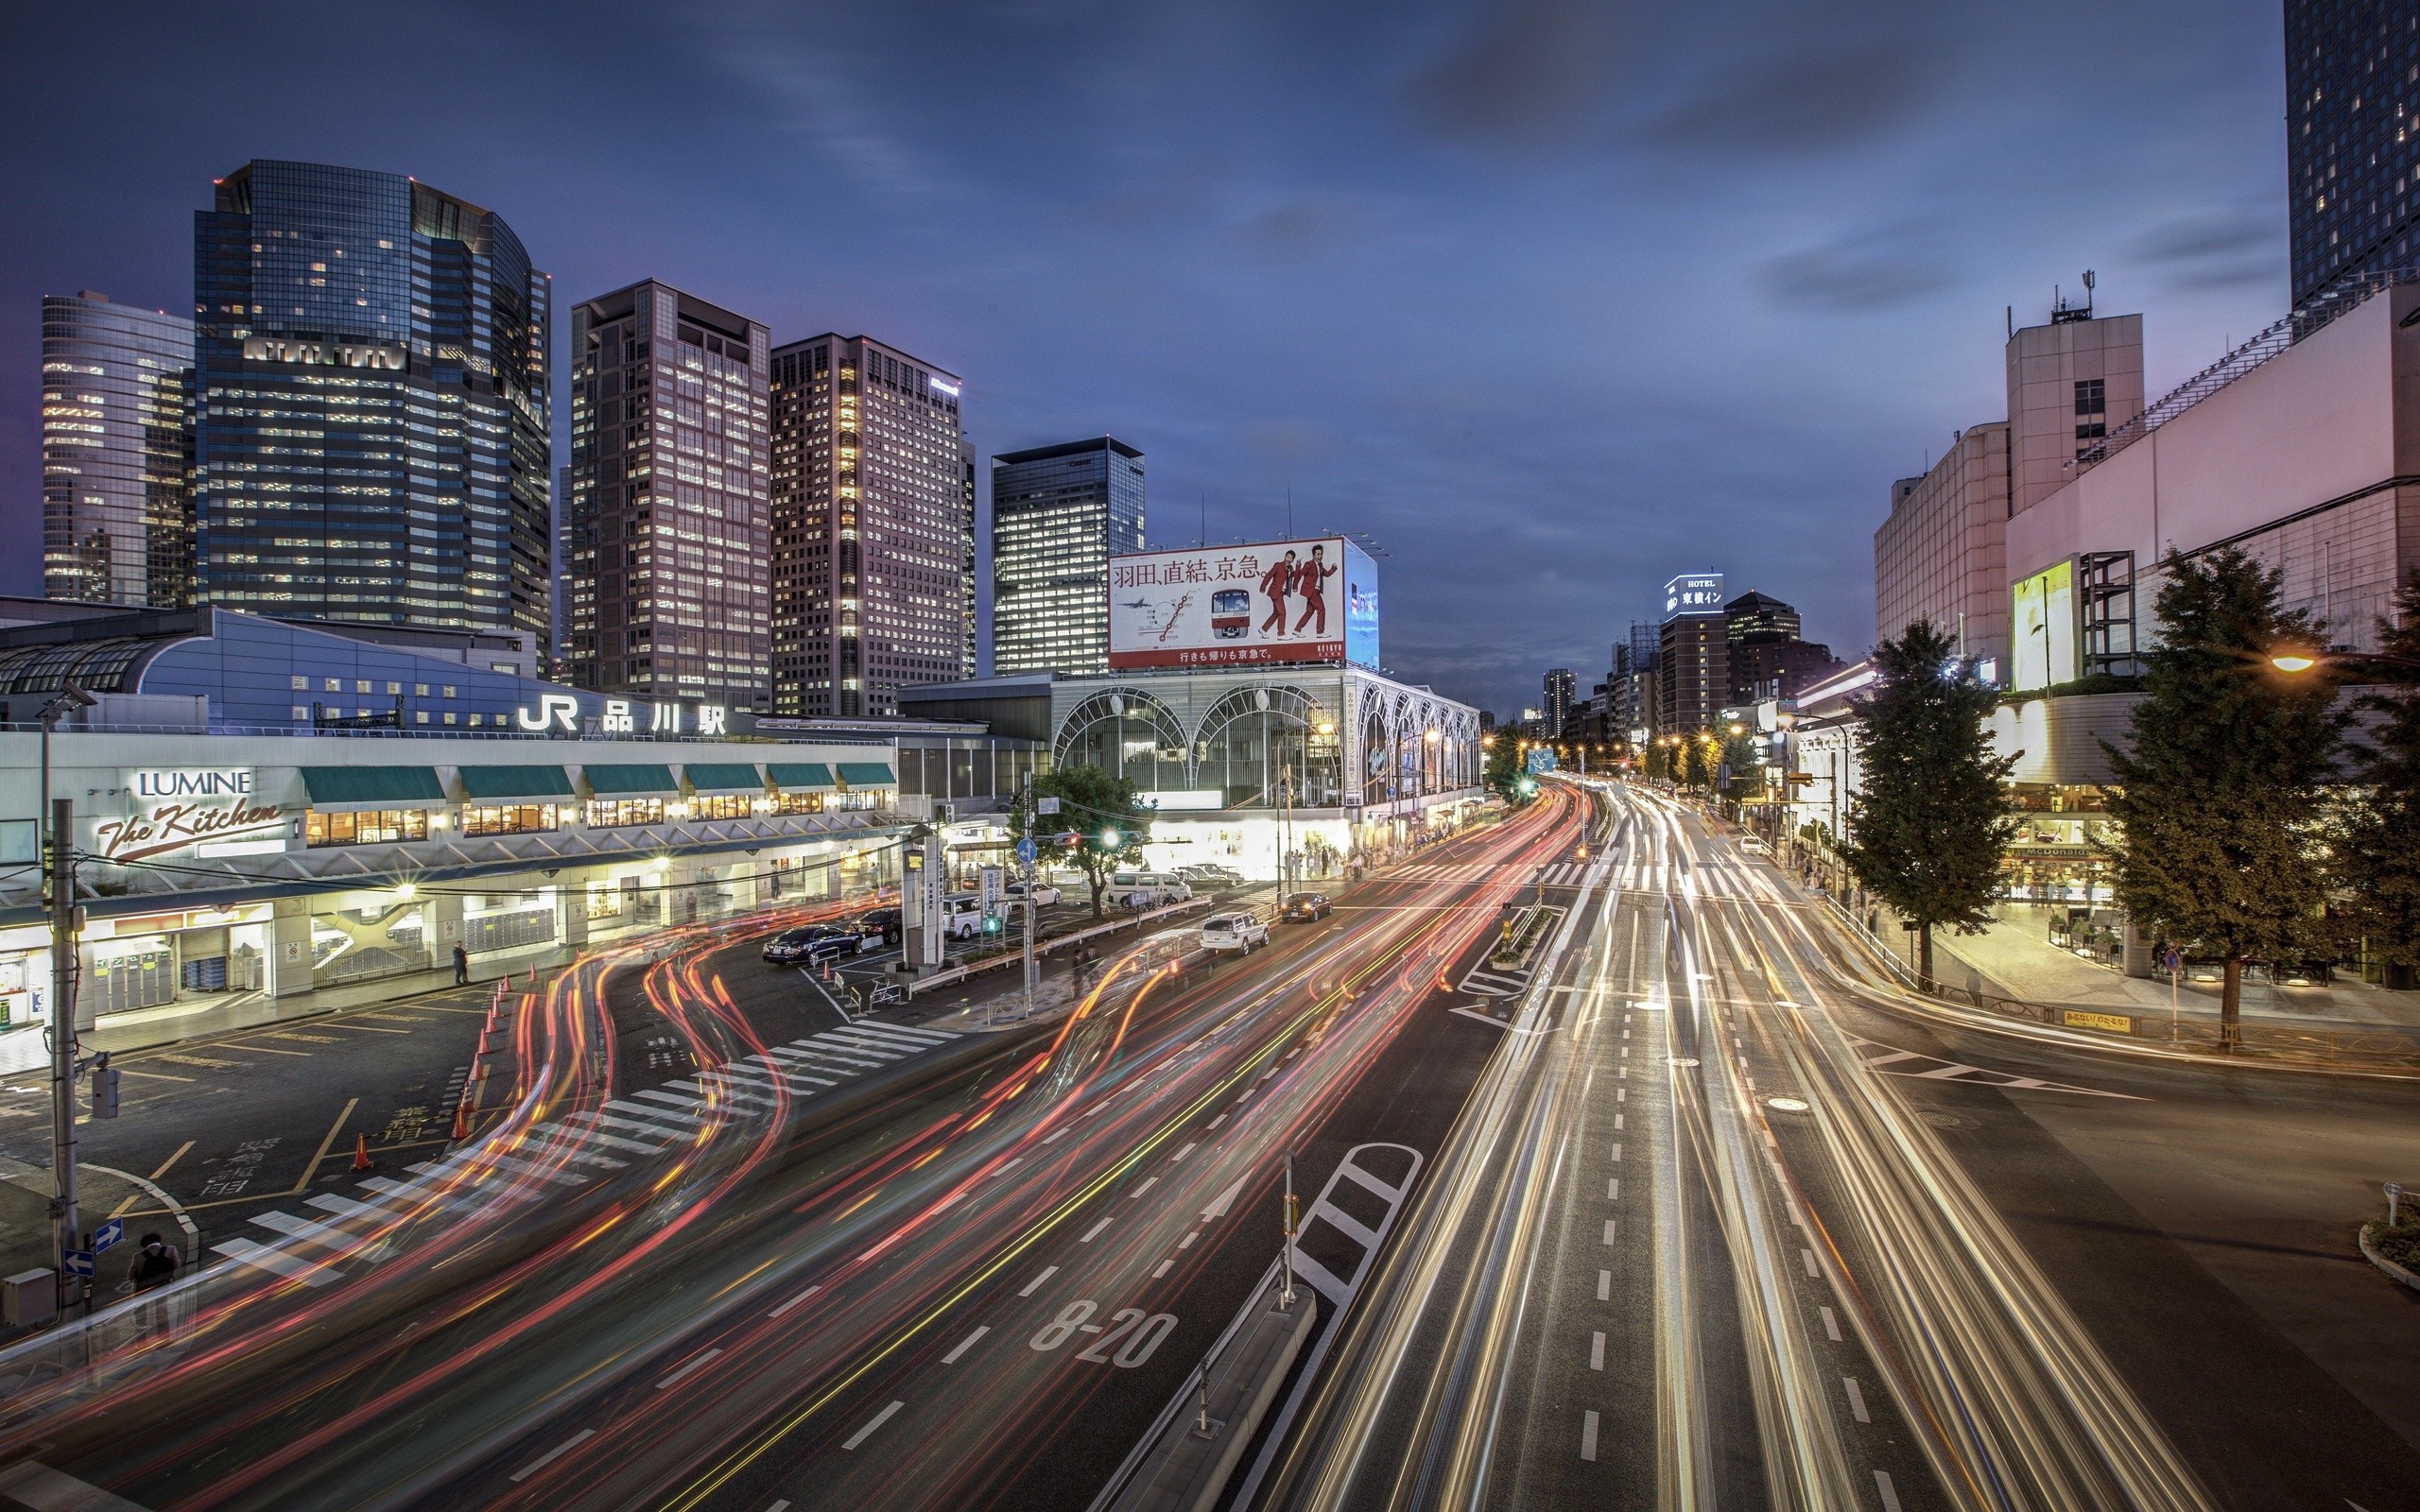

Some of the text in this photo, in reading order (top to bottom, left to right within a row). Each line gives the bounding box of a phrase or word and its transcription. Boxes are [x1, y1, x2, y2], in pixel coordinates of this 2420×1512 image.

[1114, 555, 1268, 589] 羽田、直結、京急。
[1687, 579, 1716, 588] HOTEL
[1683, 592, 1721, 605] 東横イン
[1180, 648, 1272, 662] 行きも帰りも京急で。
[519, 695, 726, 735] JR 品川駅
[140, 772, 251, 796] LUMINE
[97, 798, 284, 857] The Kitchen
[1029, 1299, 1179, 1368] 8-20
